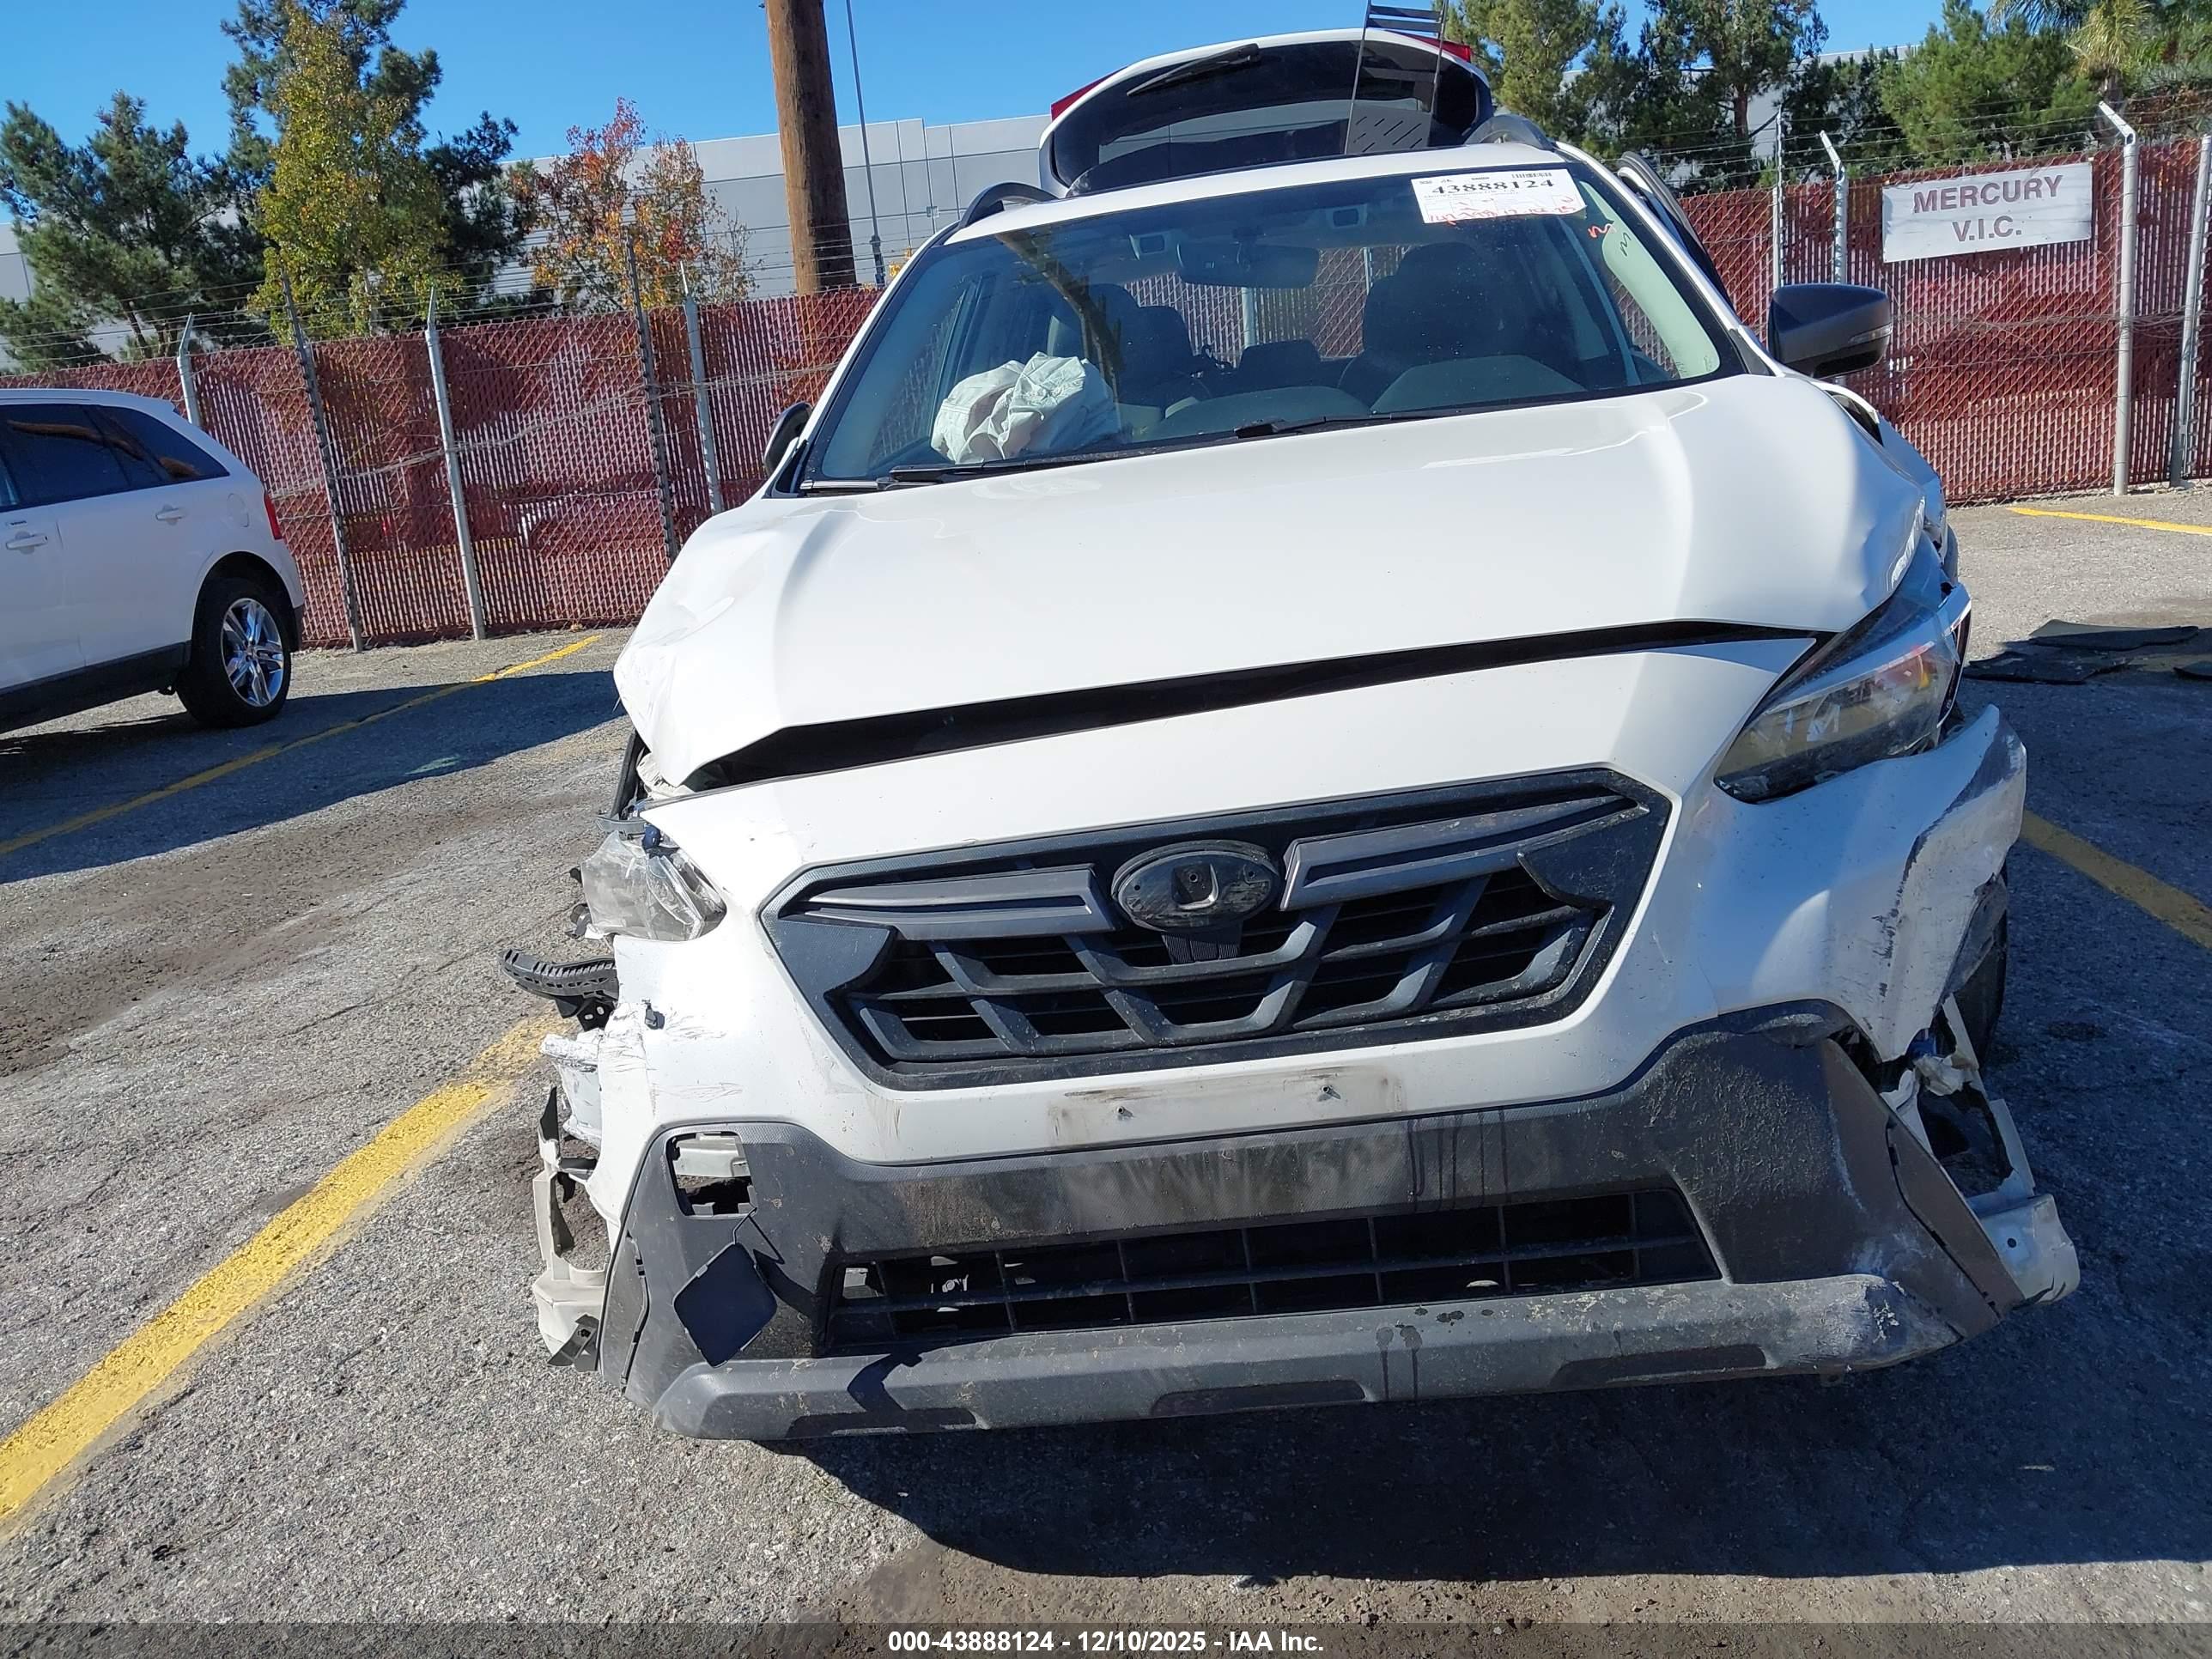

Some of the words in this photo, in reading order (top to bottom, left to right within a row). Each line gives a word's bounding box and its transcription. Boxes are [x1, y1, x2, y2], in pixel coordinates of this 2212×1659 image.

[1431, 179, 1555, 195] 43888124
[1913, 174, 2064, 214] MERCURY
[1952, 215, 2022, 242] V.I.C.
